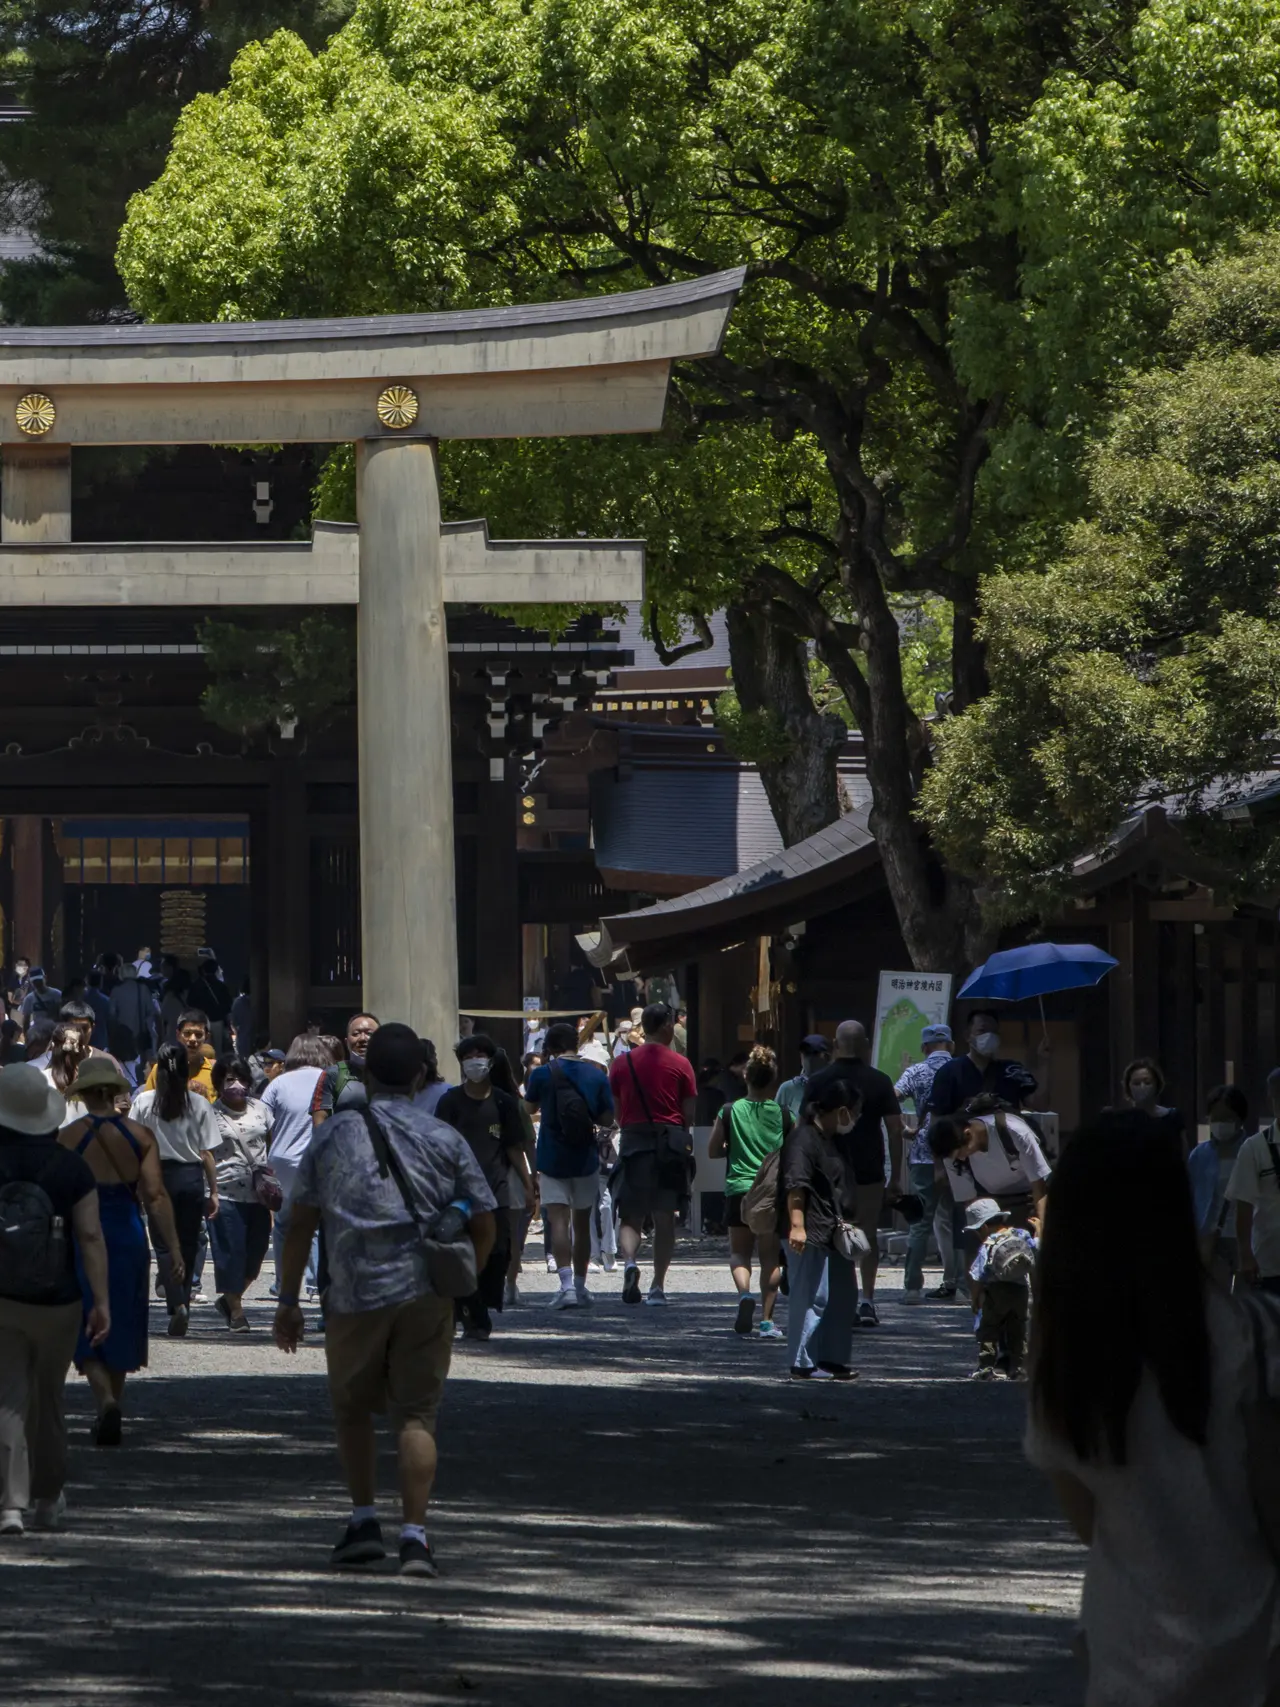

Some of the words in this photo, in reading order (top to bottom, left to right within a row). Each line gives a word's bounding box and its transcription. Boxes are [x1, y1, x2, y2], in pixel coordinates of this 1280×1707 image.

[891, 978, 943, 992] 明治神宮境内図
